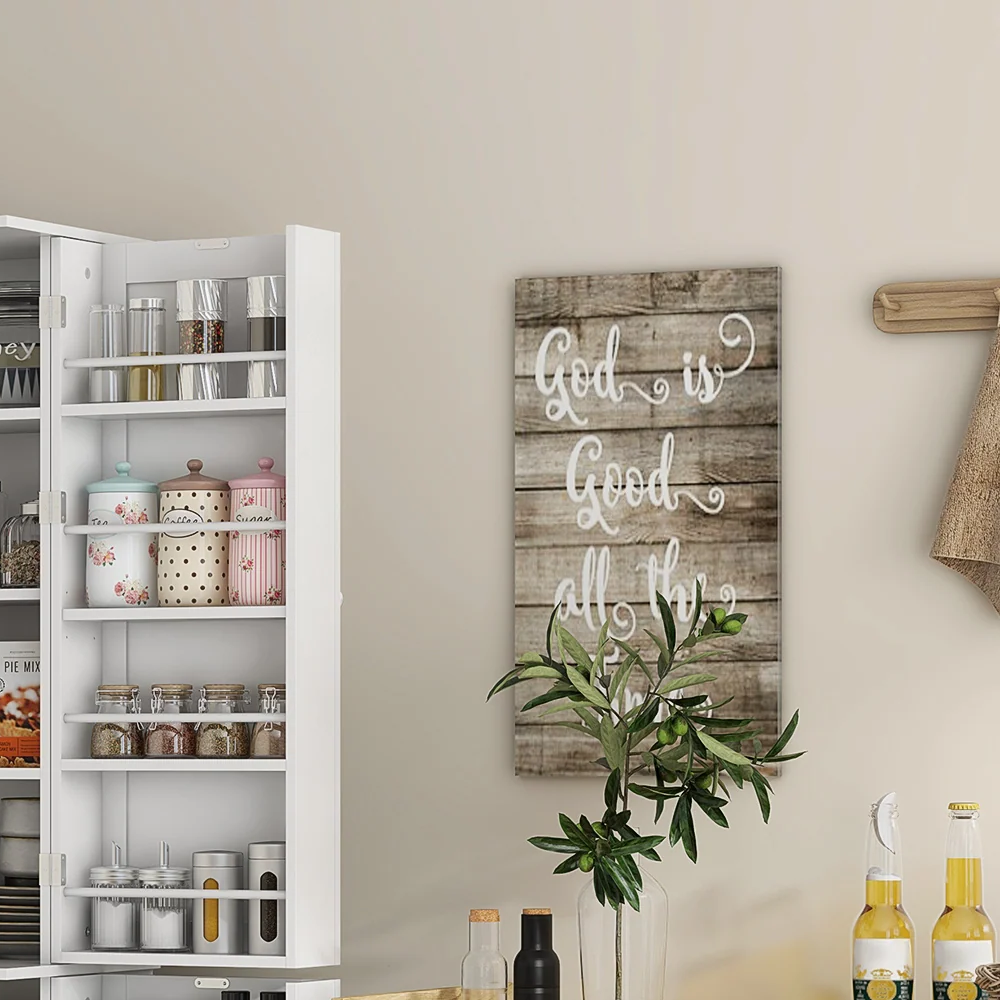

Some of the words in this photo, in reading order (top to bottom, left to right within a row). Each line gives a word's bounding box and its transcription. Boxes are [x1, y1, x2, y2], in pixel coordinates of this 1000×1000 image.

[535, 324, 669, 426] God
[682, 312, 757, 404] is
[163, 515, 199, 524] Coffee
[566, 431, 725, 536] Good
[555, 544, 636, 641] all
[4, 661, 19, 673] PIE
[23, 661, 40, 673] MIX
